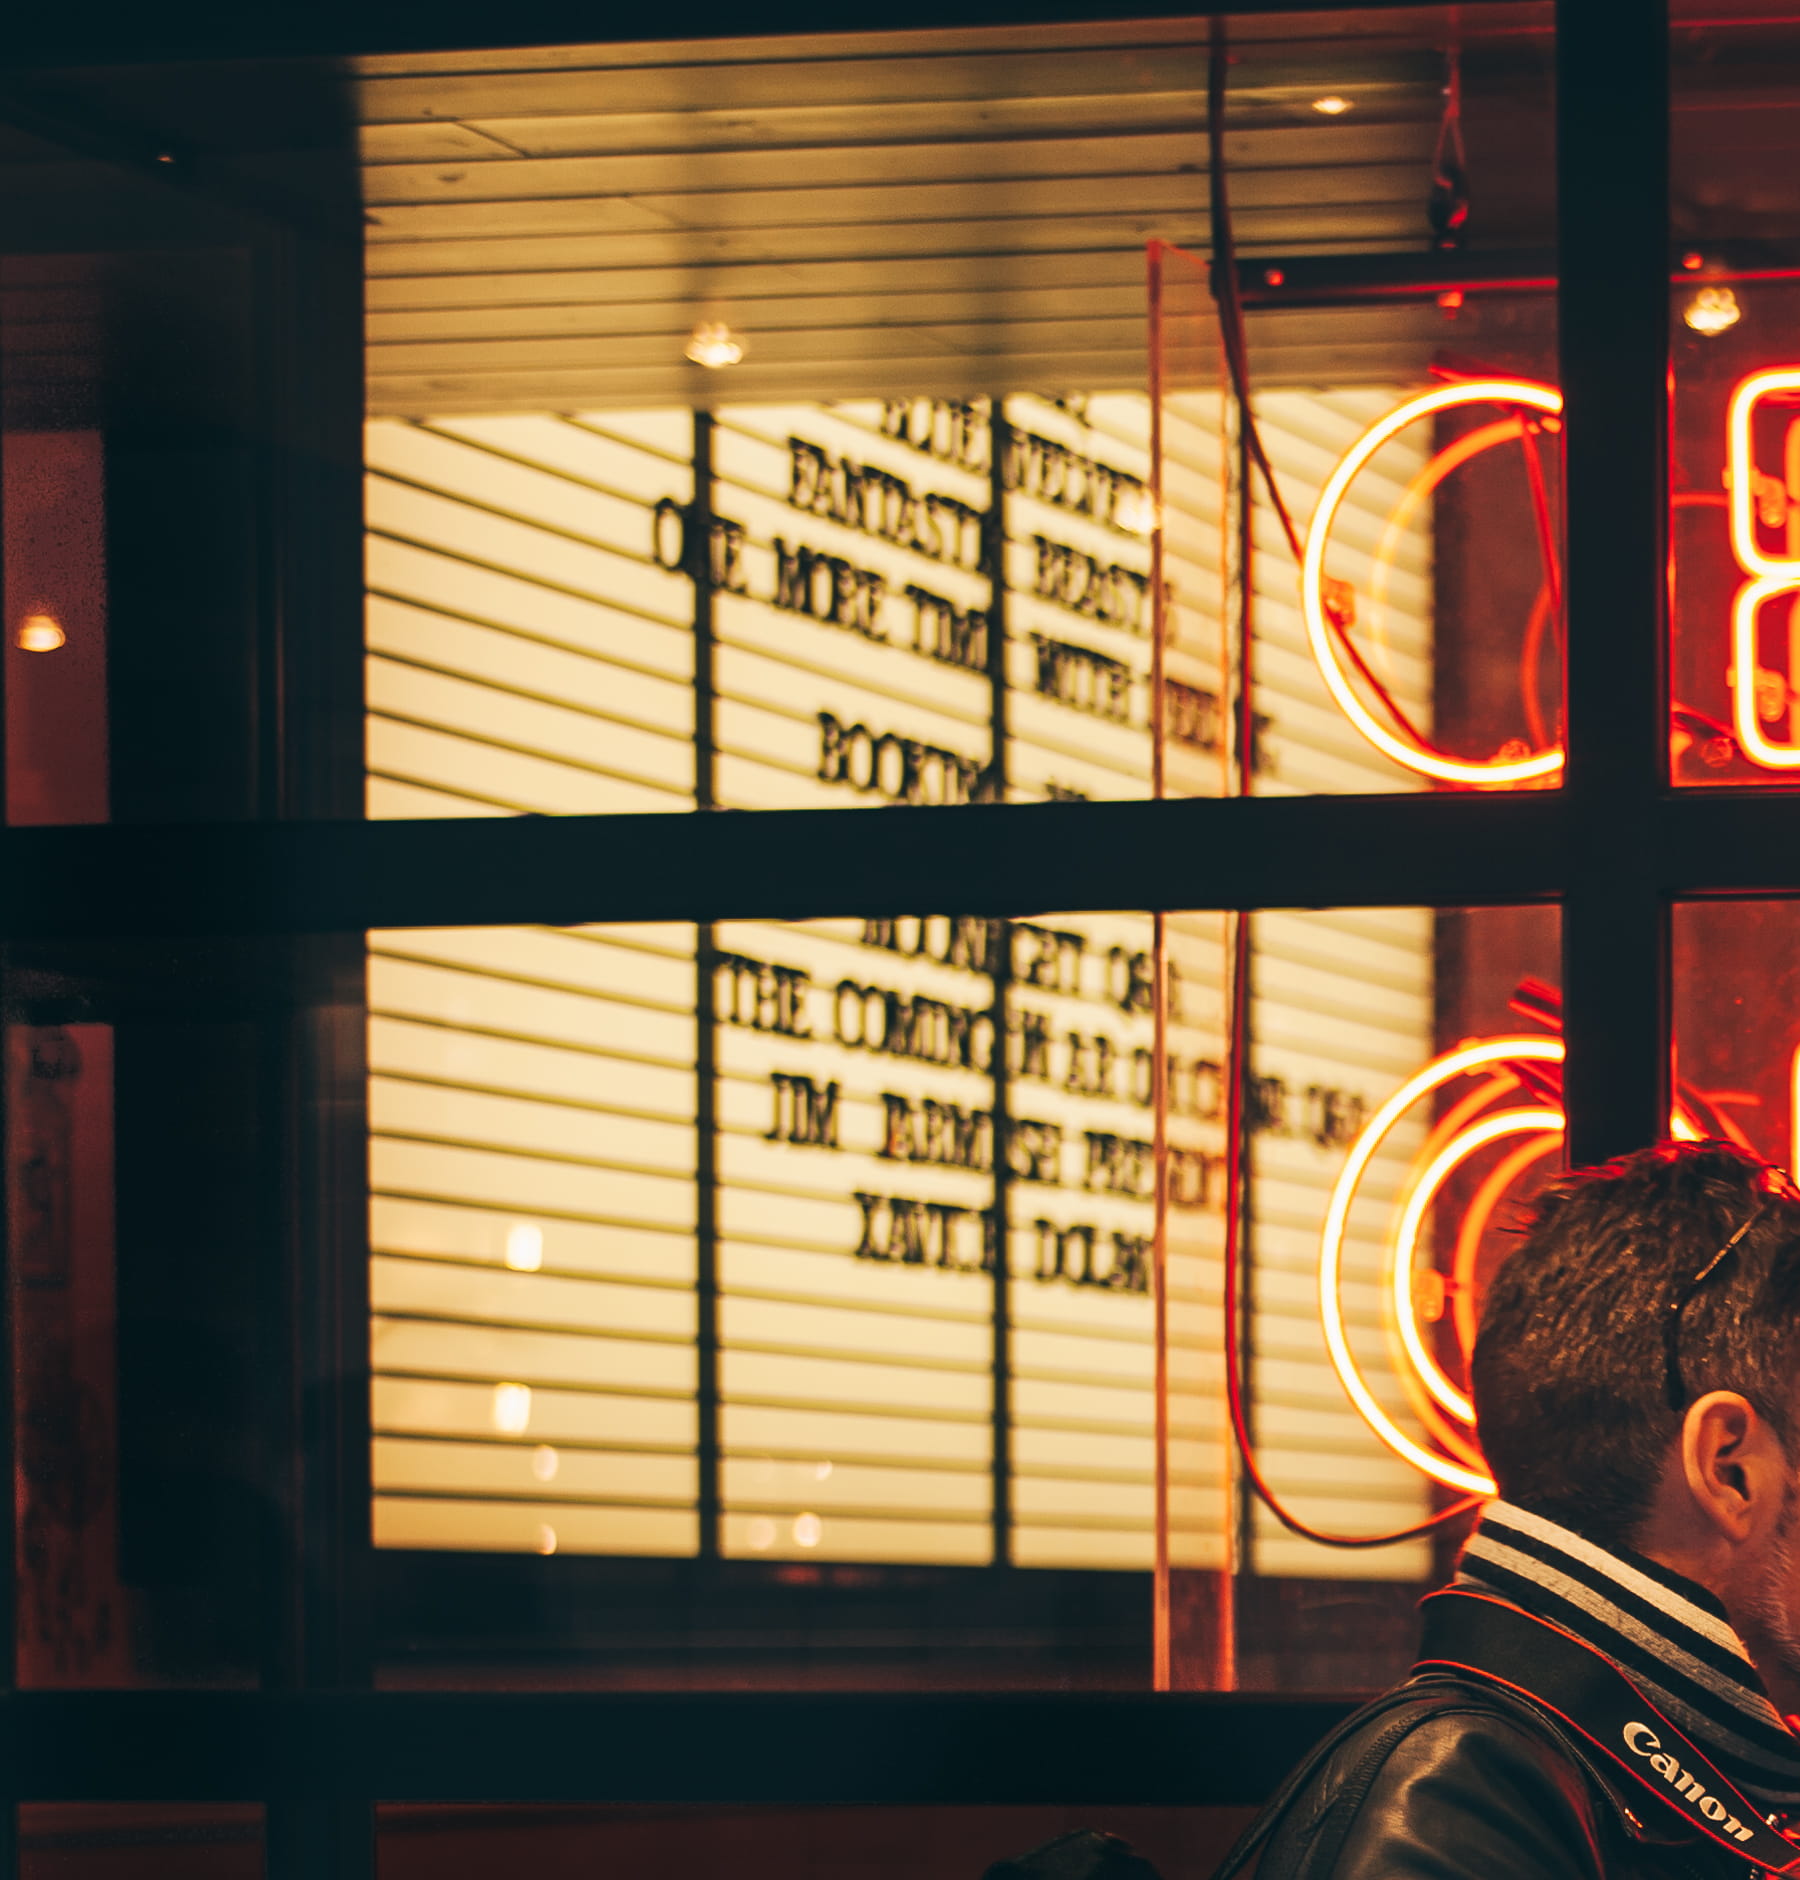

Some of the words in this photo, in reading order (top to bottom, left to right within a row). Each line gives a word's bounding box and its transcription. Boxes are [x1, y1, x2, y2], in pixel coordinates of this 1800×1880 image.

[650, 496, 748, 594] OE
[766, 1072, 838, 1148] JIM
[1622, 1720, 1755, 1844] Canon
